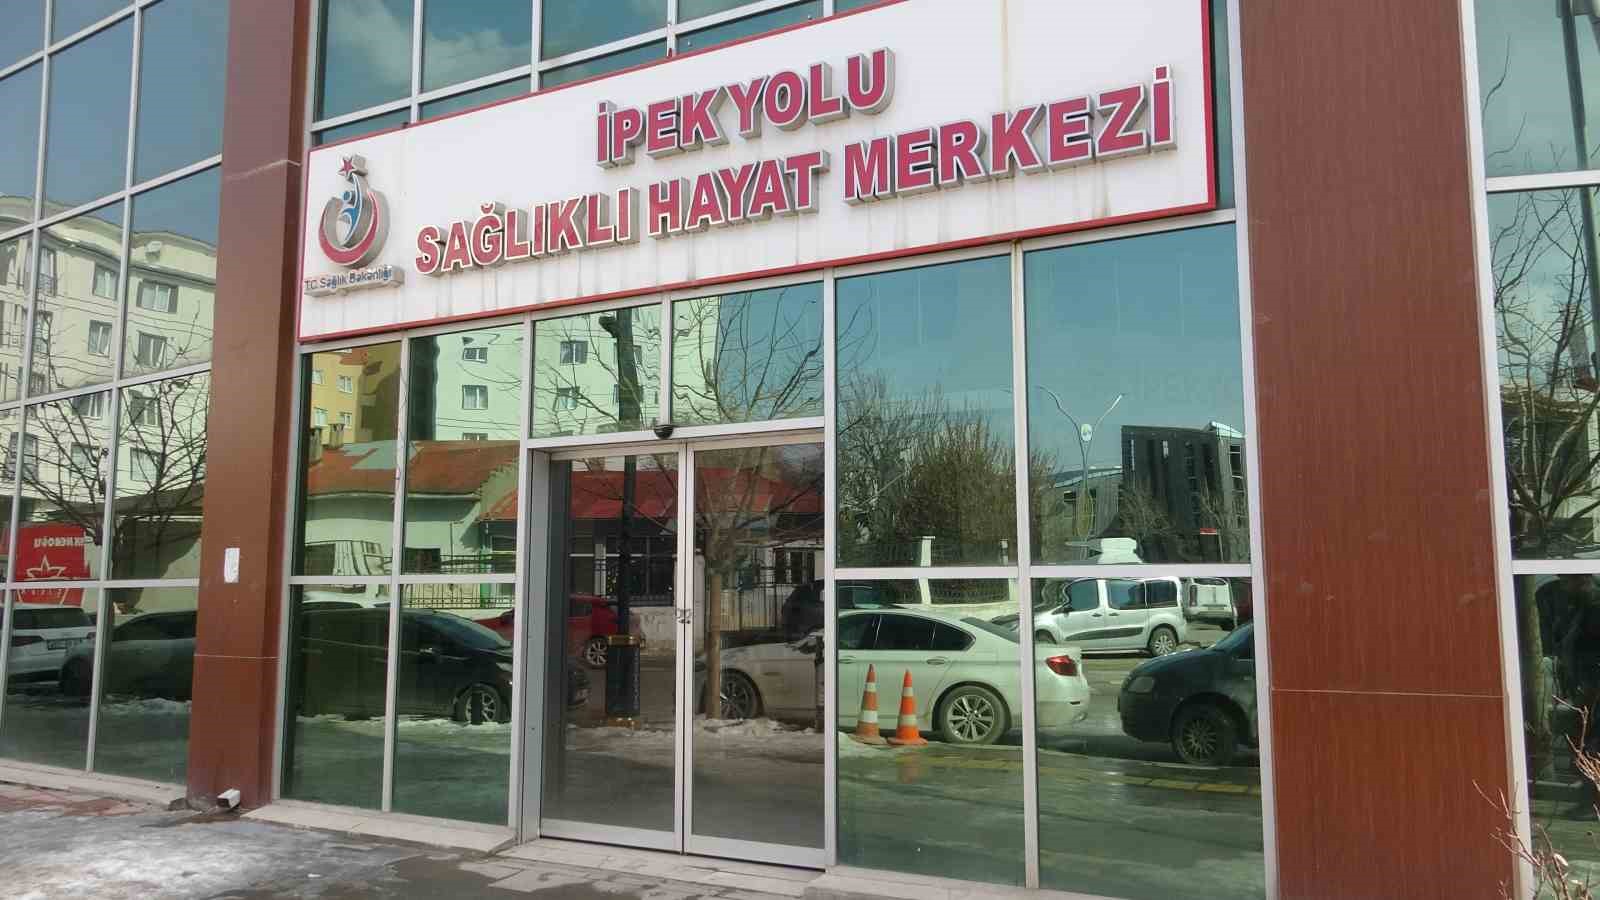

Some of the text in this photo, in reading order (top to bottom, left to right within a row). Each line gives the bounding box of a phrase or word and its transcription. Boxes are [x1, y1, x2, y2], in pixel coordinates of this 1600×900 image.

[415, 64, 1175, 275] SAĞLIKLI HAYAT MERKEZİ
[319, 272, 348, 289] Sağlık
[349, 264, 393, 284] Bakanlığı
